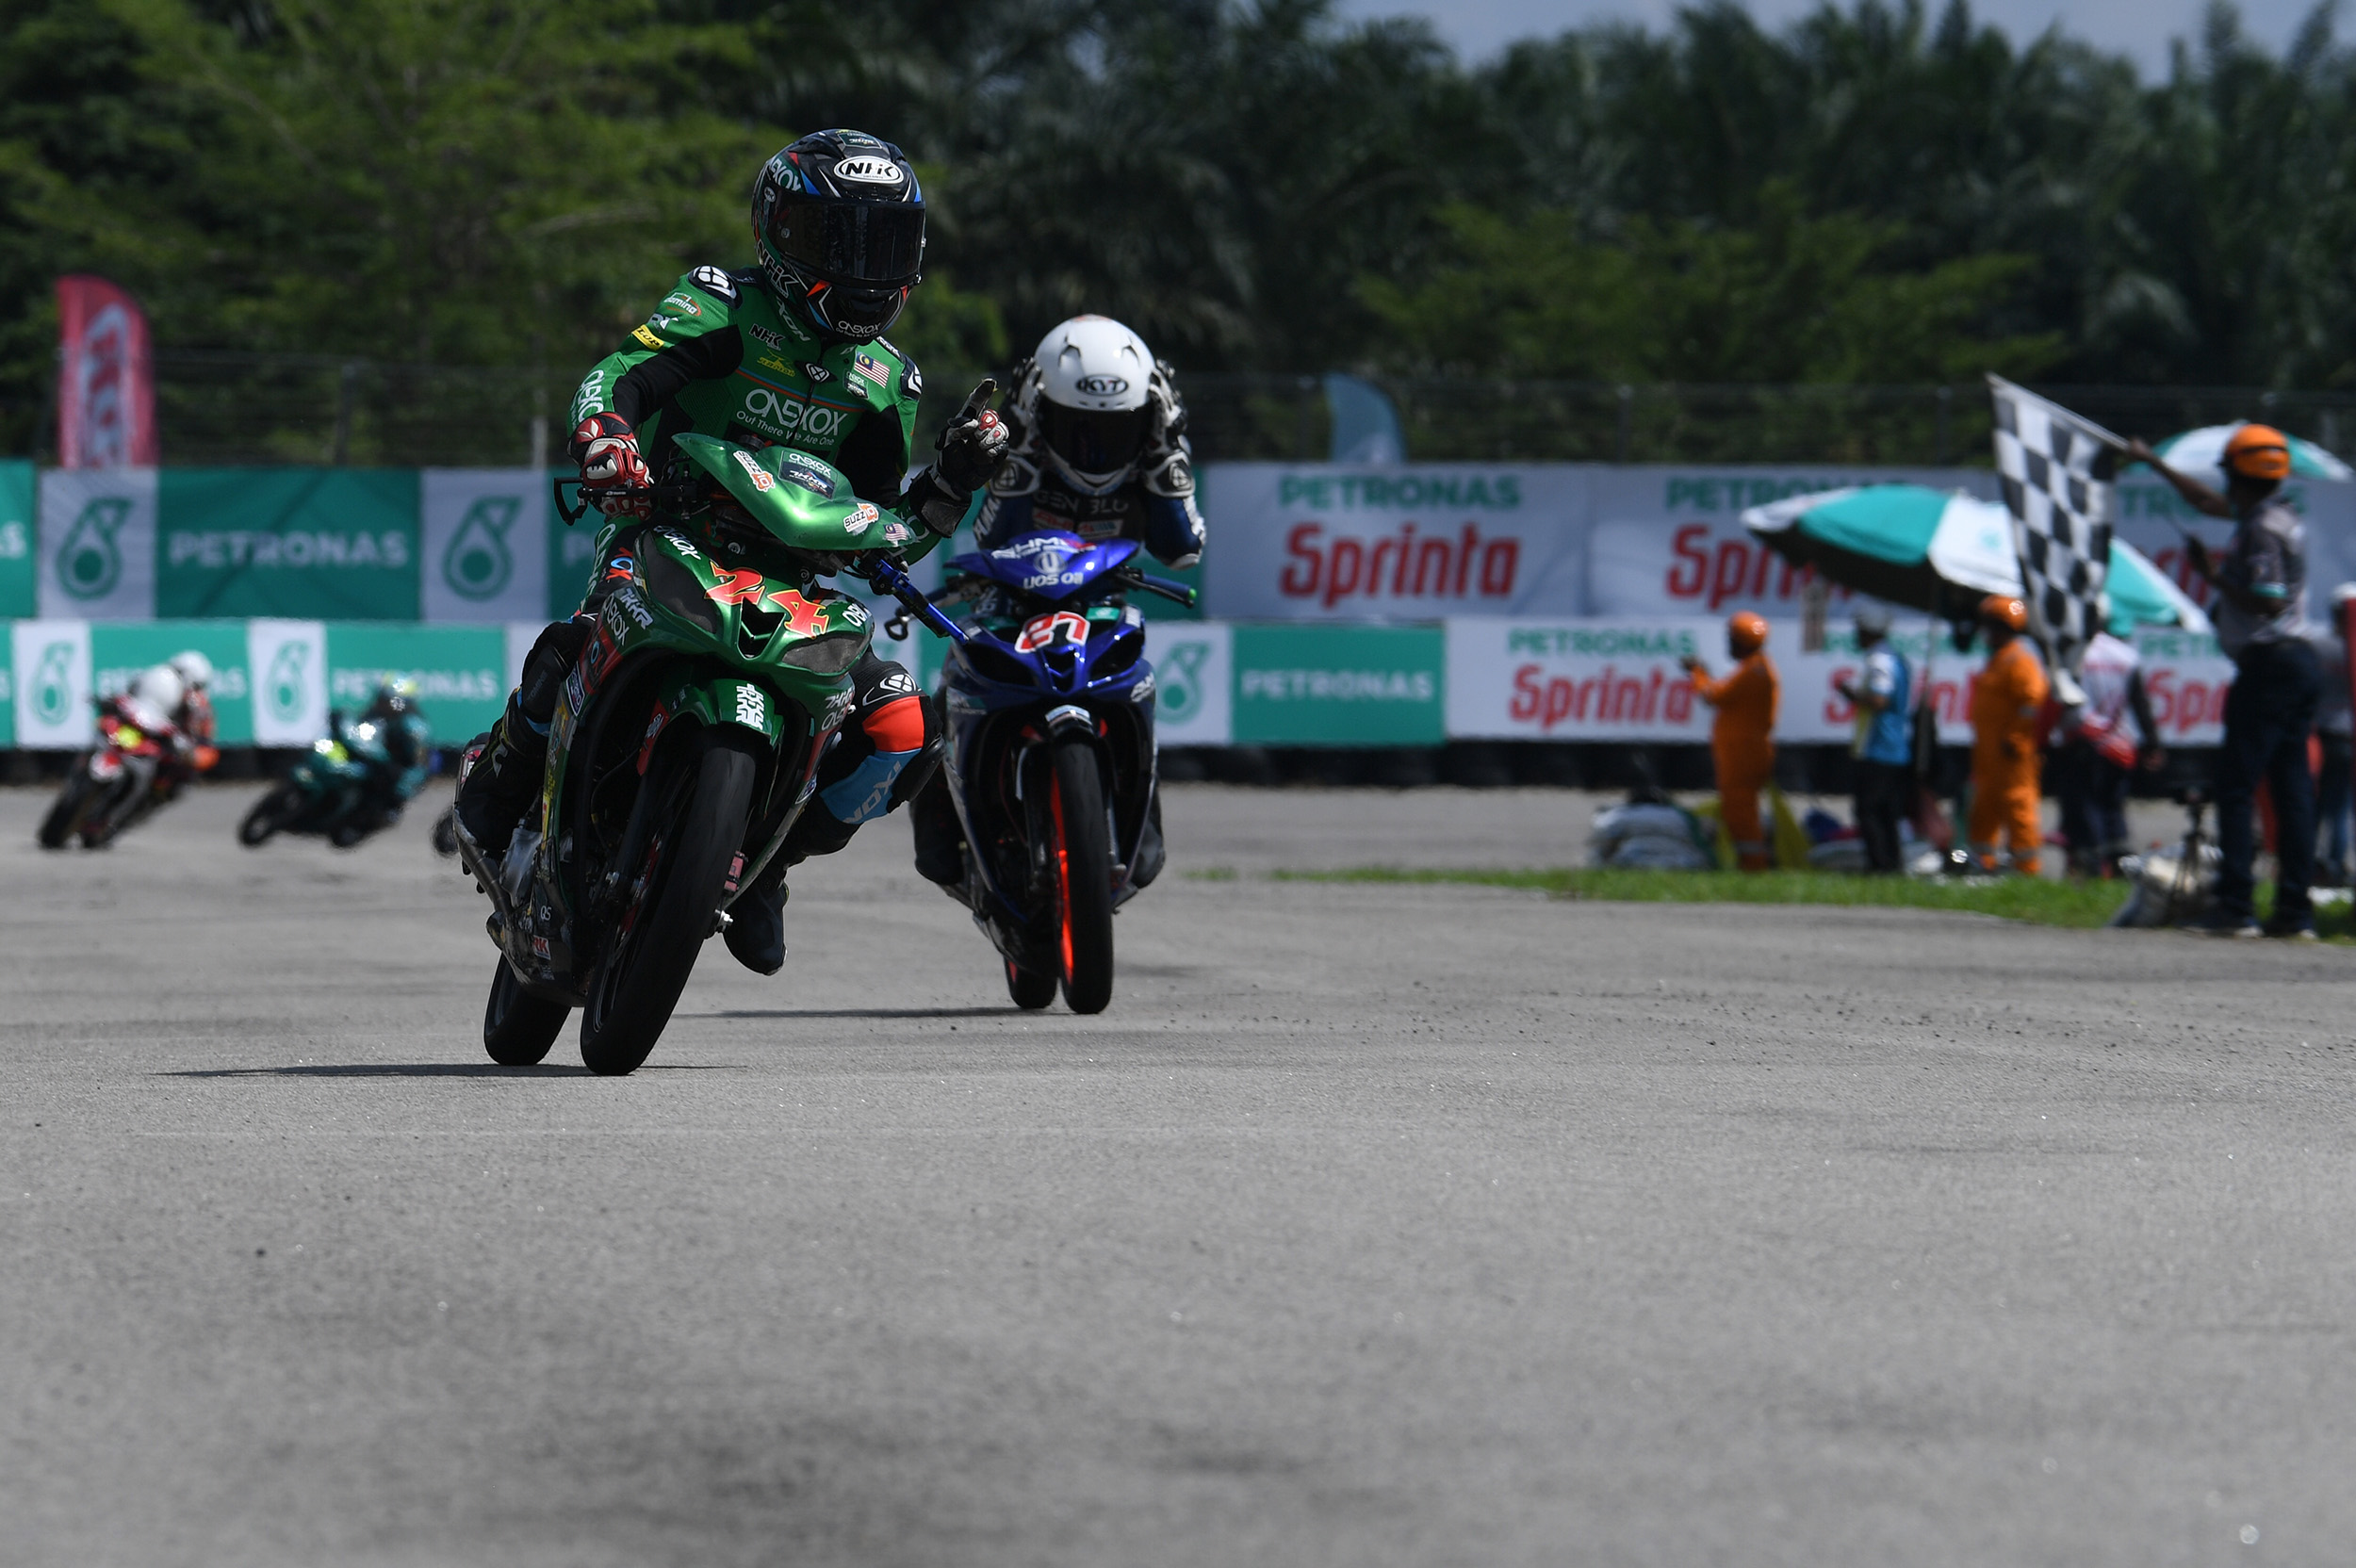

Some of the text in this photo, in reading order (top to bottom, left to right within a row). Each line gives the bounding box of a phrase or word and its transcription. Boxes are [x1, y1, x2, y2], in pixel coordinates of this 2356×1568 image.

[736, 410, 757, 425] Out
[758, 419, 784, 437] There
[1280, 475, 1521, 510] PETRONAS
[170, 531, 407, 567] PETRONAS
[1280, 522, 1521, 610] Sprinta
[1509, 629, 1694, 657] PETRONAS
[1241, 670, 1434, 701] PETRONAS
[1510, 663, 1694, 733] Sprinta
